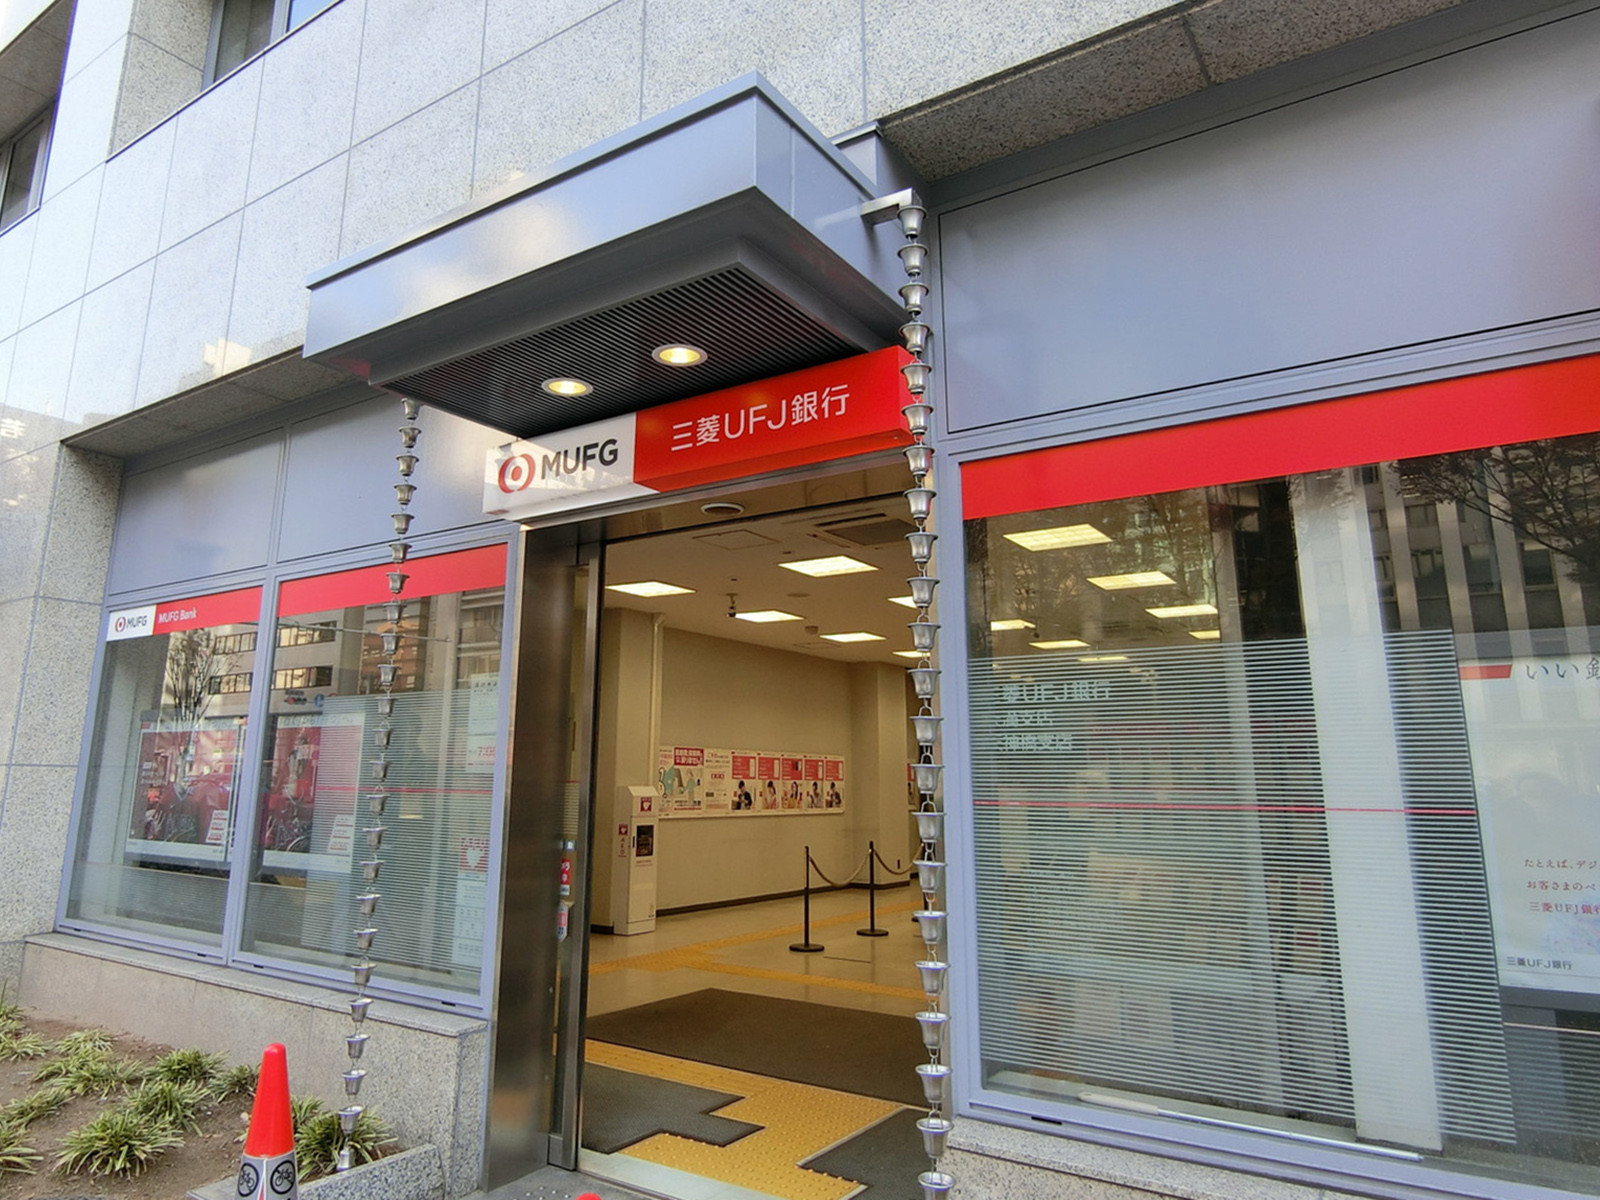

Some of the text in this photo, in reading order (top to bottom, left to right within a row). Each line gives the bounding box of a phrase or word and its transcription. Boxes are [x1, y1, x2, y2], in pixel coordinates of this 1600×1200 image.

[671, 384, 850, 451] 三菱UFJ銀行
[541, 438, 619, 480] MUFG
[127, 616, 147, 628] MUFG
[158, 607, 198, 623] MUFG Bank
[1524, 859, 1600, 869] たとえば、デジ
